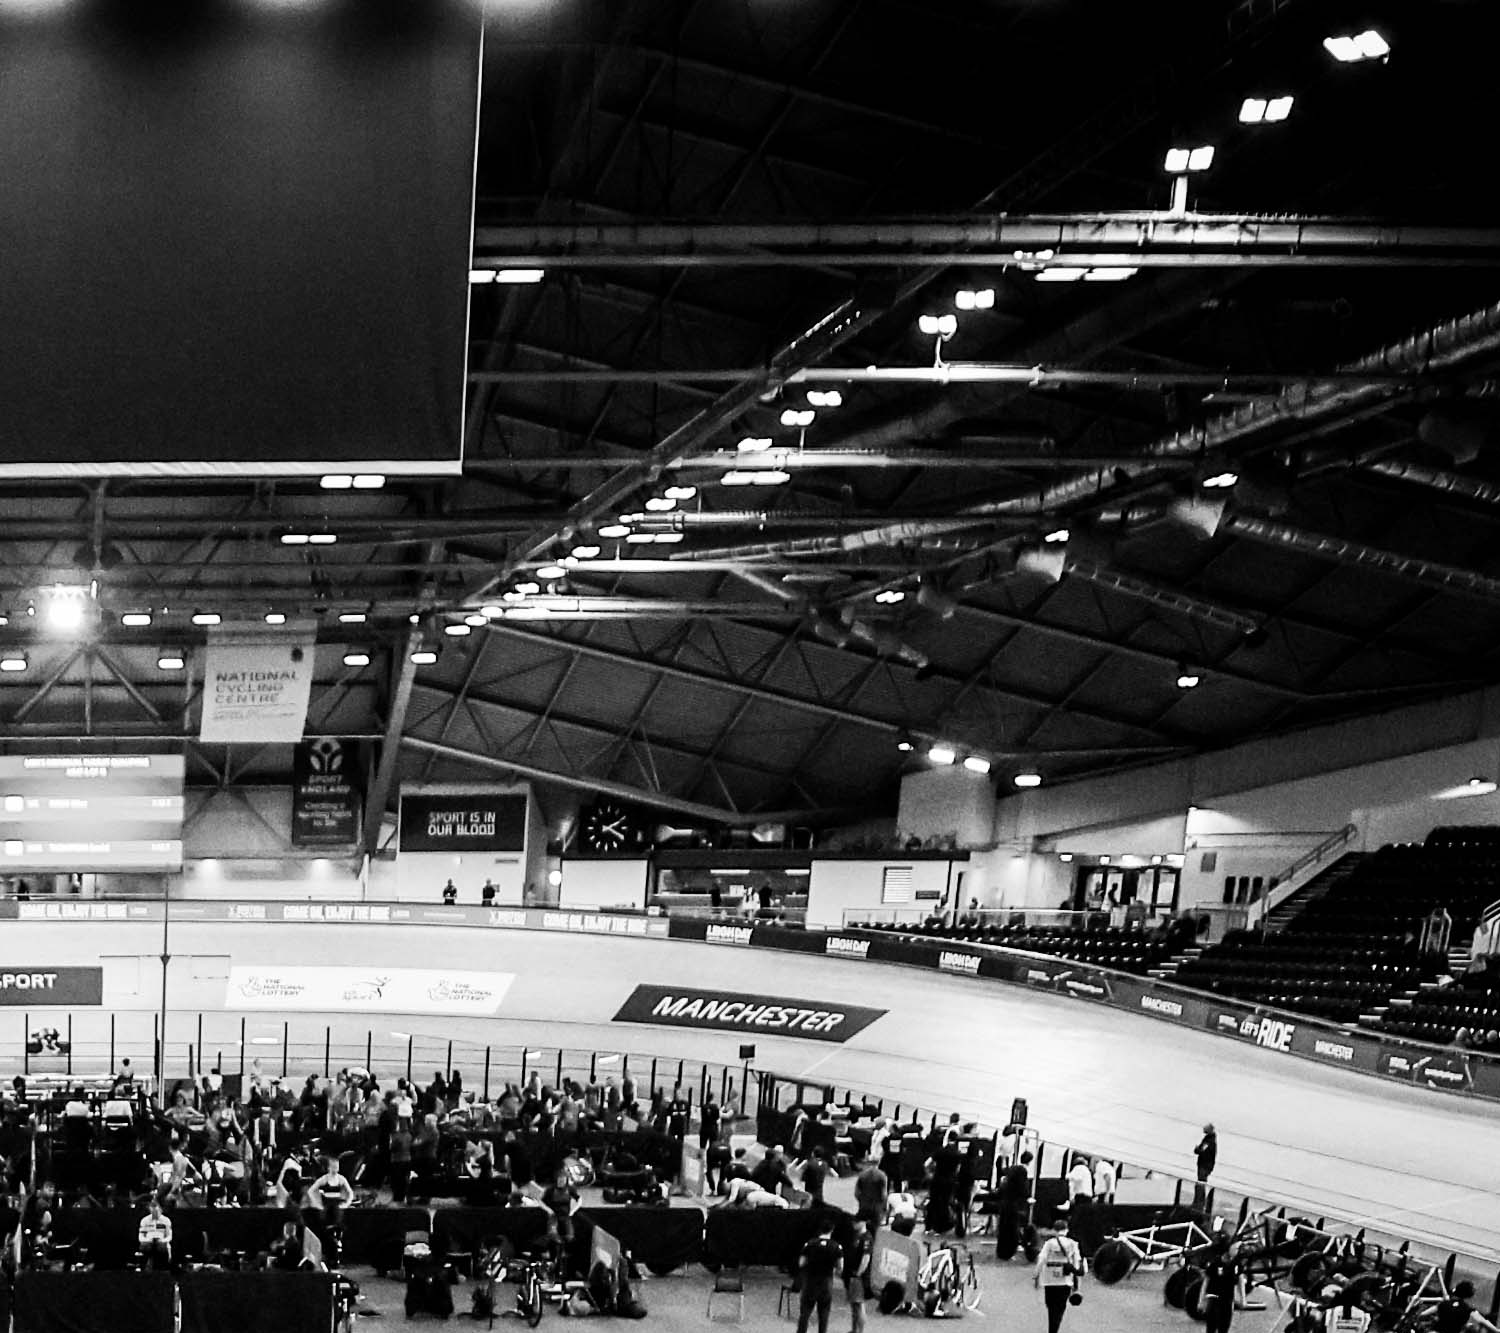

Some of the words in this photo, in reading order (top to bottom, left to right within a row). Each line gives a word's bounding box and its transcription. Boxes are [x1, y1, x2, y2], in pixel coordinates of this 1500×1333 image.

[215, 671, 300, 682] NATIONAL
[216, 683, 285, 693] CYCLING
[215, 694, 280, 704] CENTRE
[429, 811, 465, 823] SPORT
[470, 811, 480, 823] IS
[484, 811, 496, 823] IN
[427, 823, 453, 836] OUR
[456, 823, 496, 836] BLOOD
[1141, 995, 1183, 1016] MANCHESTER
[652, 995, 845, 1033] MANCHESTER
[1256, 1017, 1296, 1052] RIDE
[1315, 1040, 1354, 1061] MANCHESTER
